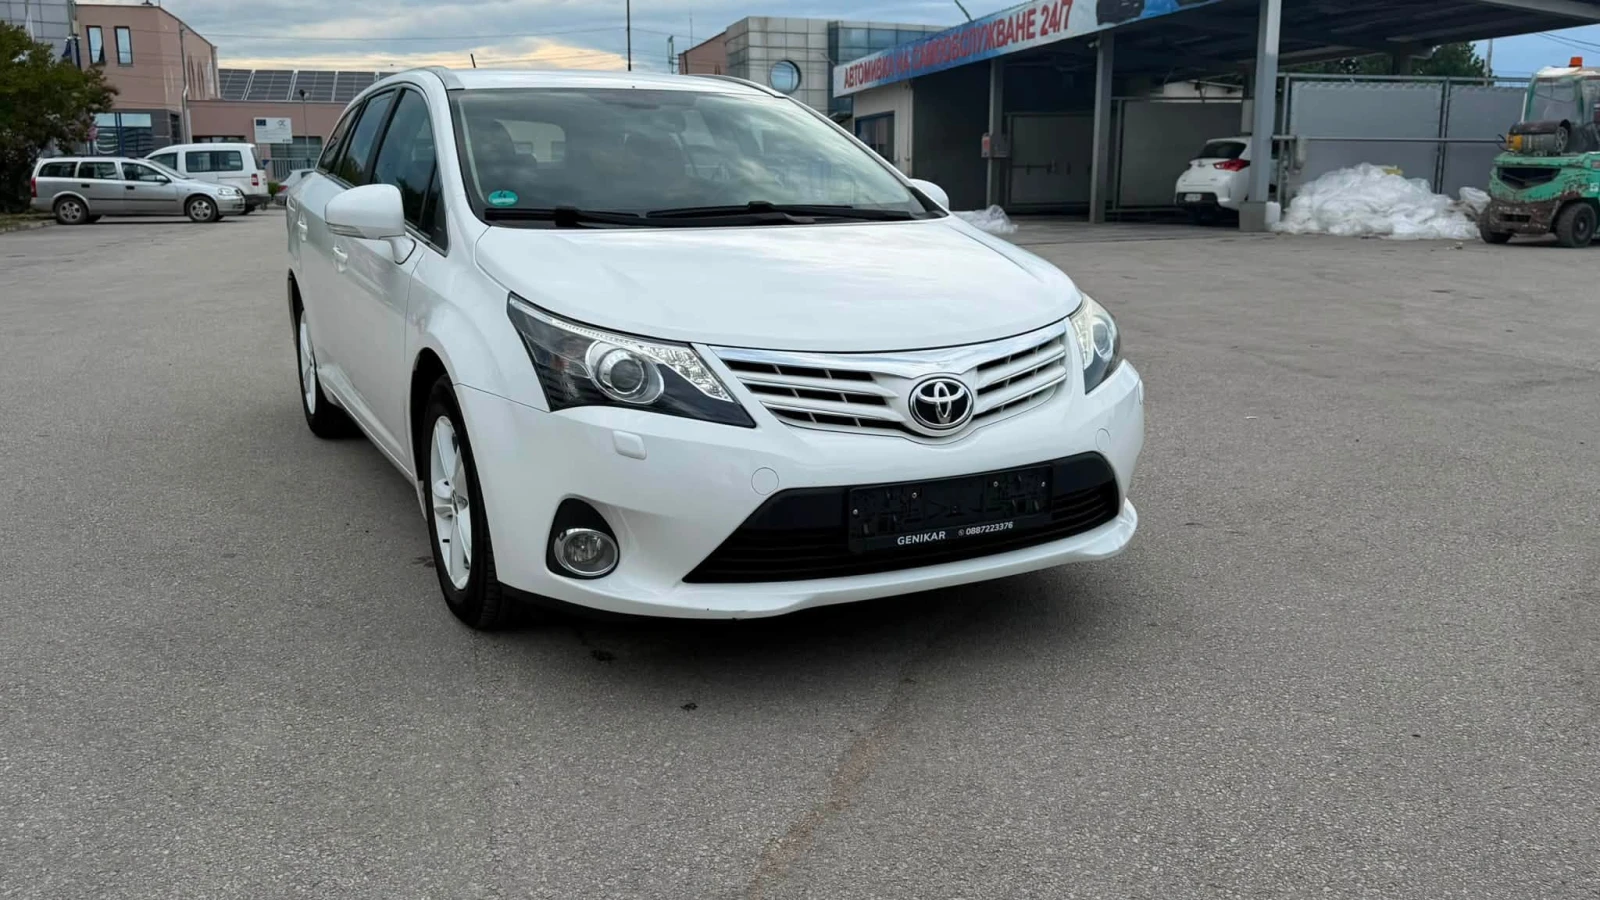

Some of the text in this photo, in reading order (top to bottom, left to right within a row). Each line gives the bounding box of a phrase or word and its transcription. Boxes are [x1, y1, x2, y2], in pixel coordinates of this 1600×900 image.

[844, 56, 894, 89] АВТОМИВКА
[1040, 0, 1073, 36] 24/7
[897, 521, 1014, 546] GENIKAR 0887223376
